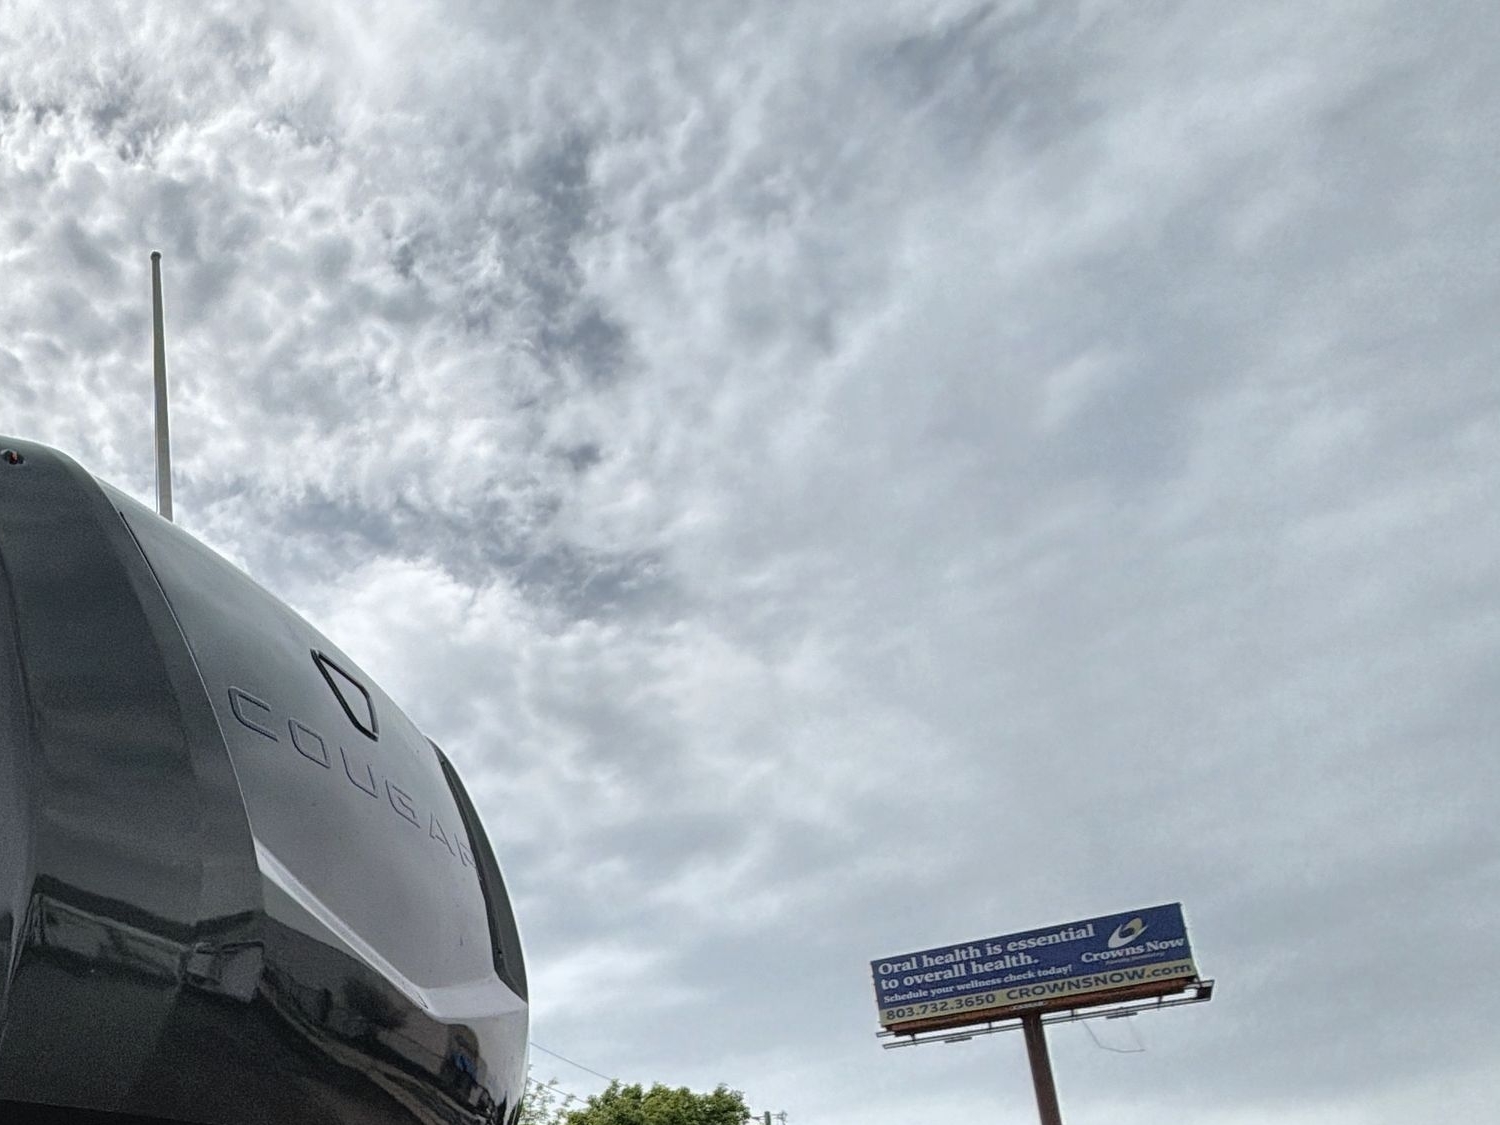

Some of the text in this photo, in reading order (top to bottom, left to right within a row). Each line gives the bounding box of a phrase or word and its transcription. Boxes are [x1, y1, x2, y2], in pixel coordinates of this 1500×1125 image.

[227, 684, 477, 869] COUGAR
[878, 923, 1095, 975] Oral health is essential
[881, 952, 1039, 991] to overall health.
[1080, 944, 1145, 963] Crowns
[1146, 937, 1185, 952] Now
[883, 965, 1073, 1004] Schedule your wellness check today!
[886, 963, 1192, 1021] 803.732.3650 CROWNSNOW.com
